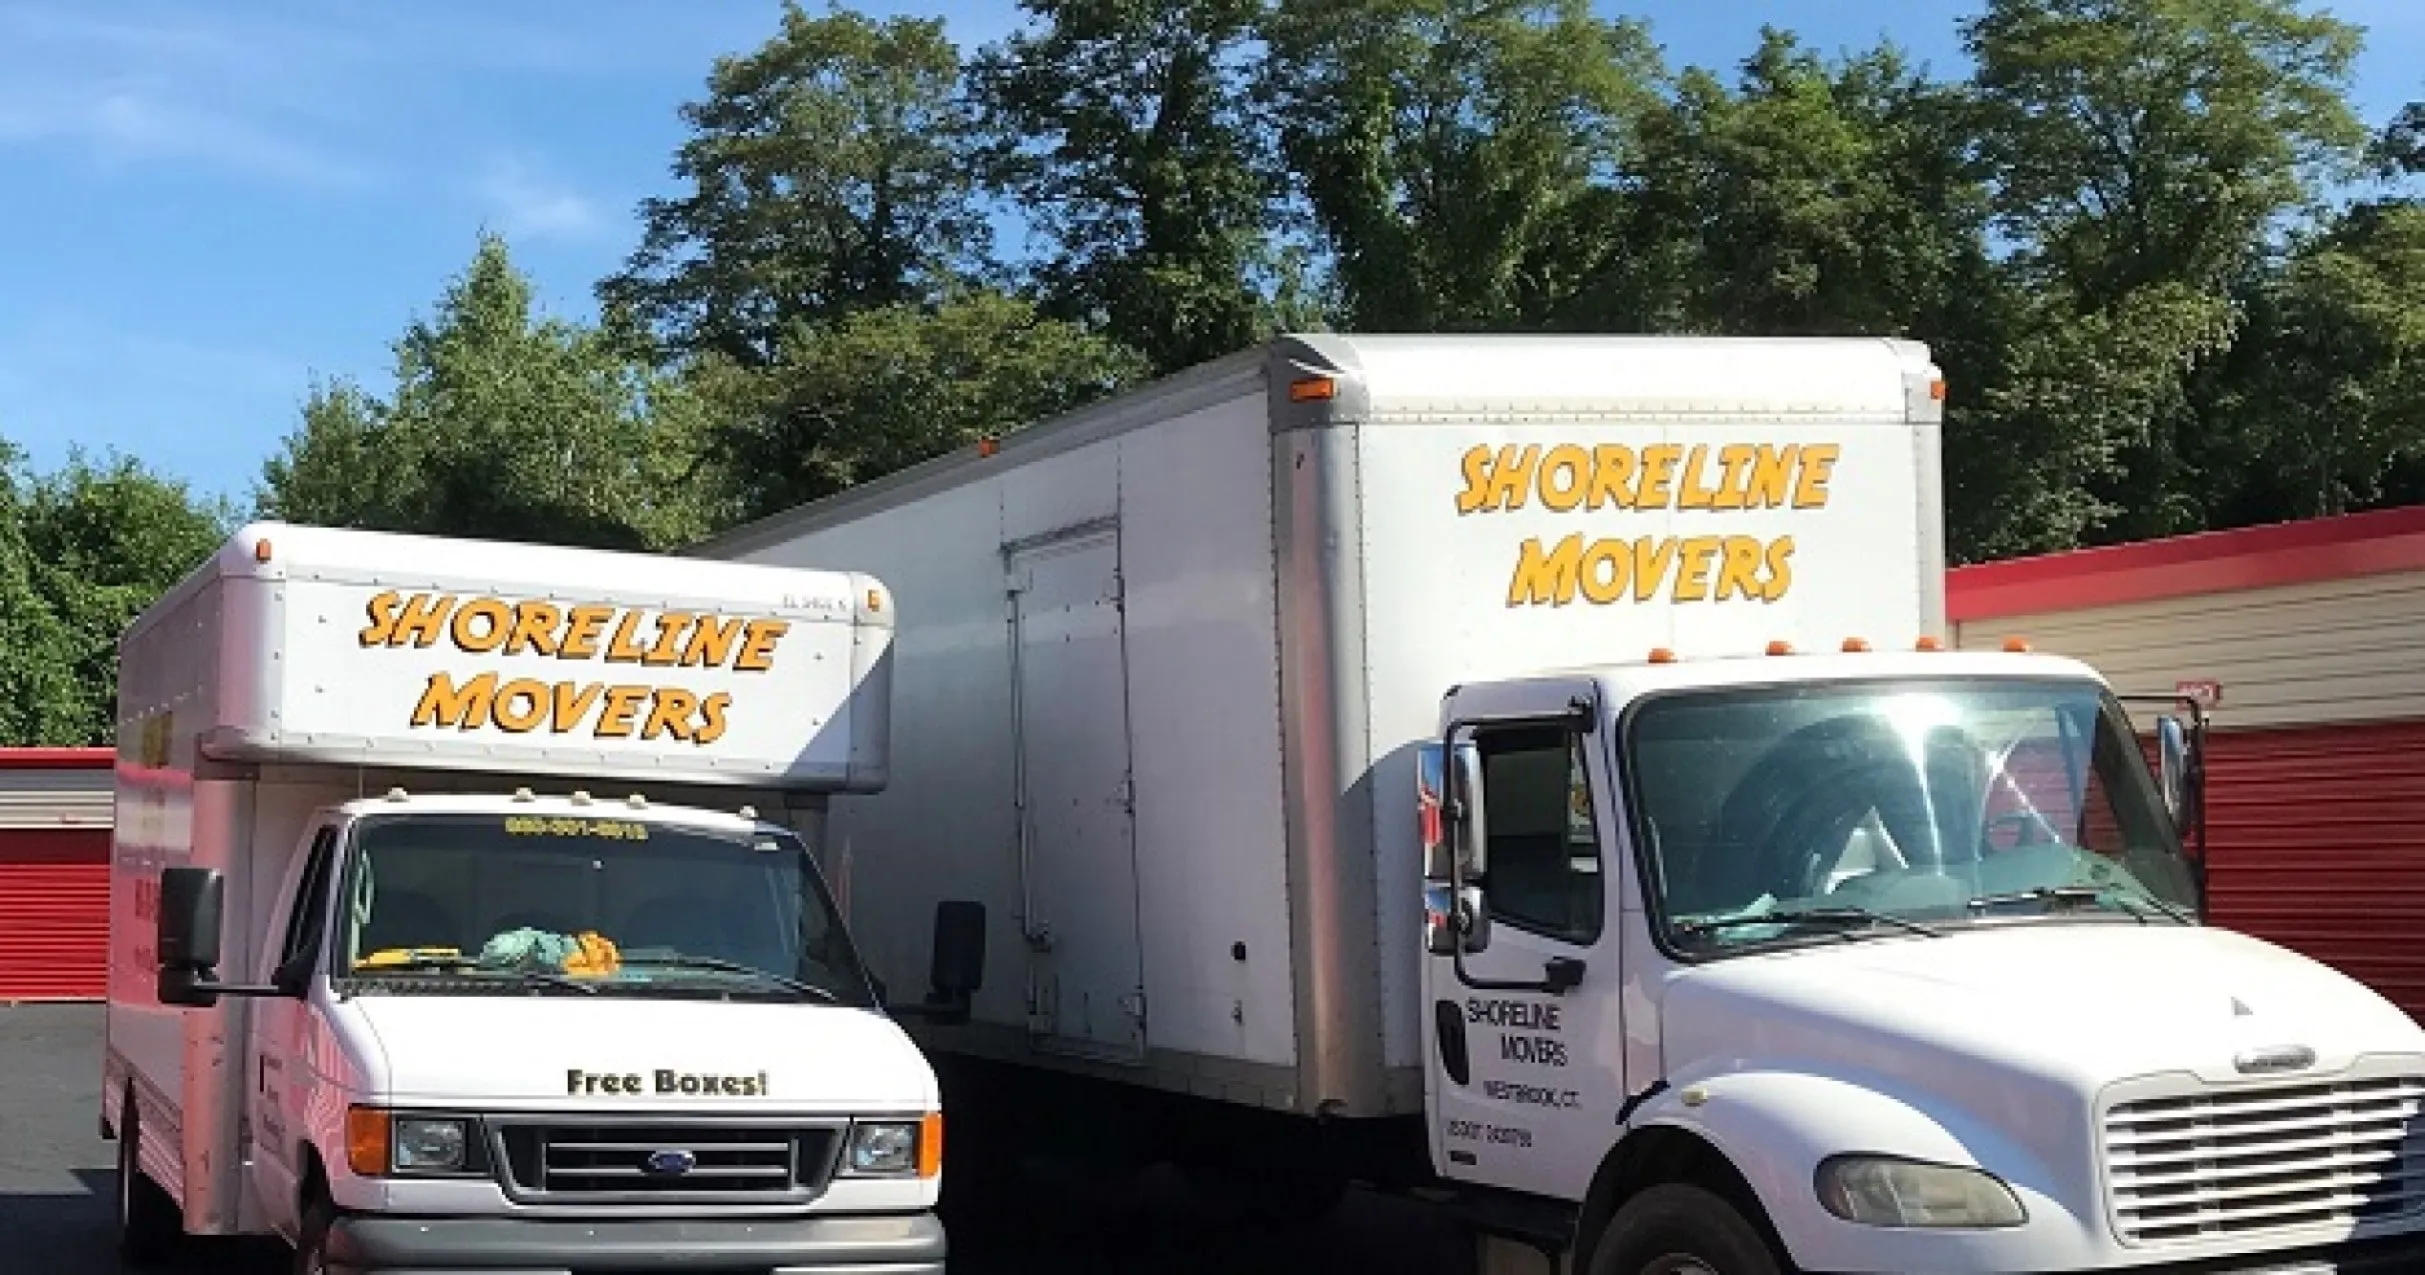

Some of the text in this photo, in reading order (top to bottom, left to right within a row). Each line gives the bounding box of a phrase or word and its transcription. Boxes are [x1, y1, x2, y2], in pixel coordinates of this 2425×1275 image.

[1455, 442, 1841, 516] SHORELINE
[1506, 532, 1796, 608] MOVERS
[359, 589, 791, 671] SHORELINE
[409, 670, 733, 744] MOVERS
[1467, 998, 1562, 1030] SHORELINE
[1500, 1034, 1569, 1066] MOVERS
[566, 1069, 768, 1096] Free Boxes!
